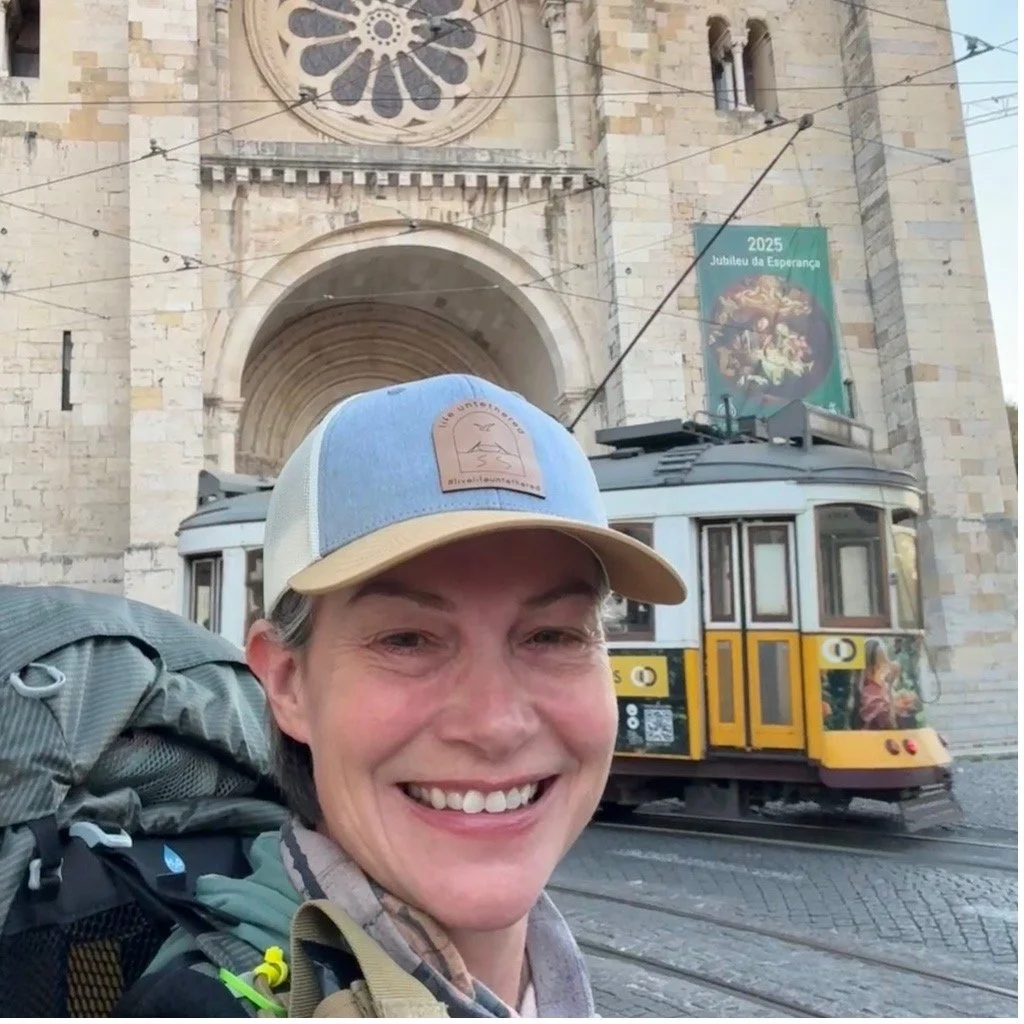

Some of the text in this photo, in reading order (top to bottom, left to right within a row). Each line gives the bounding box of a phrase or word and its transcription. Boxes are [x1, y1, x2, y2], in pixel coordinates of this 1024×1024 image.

[747, 236, 783, 252] 2025
[709, 255, 821, 271] Jubileu da Esperança
[457, 400, 526, 435] untethered
